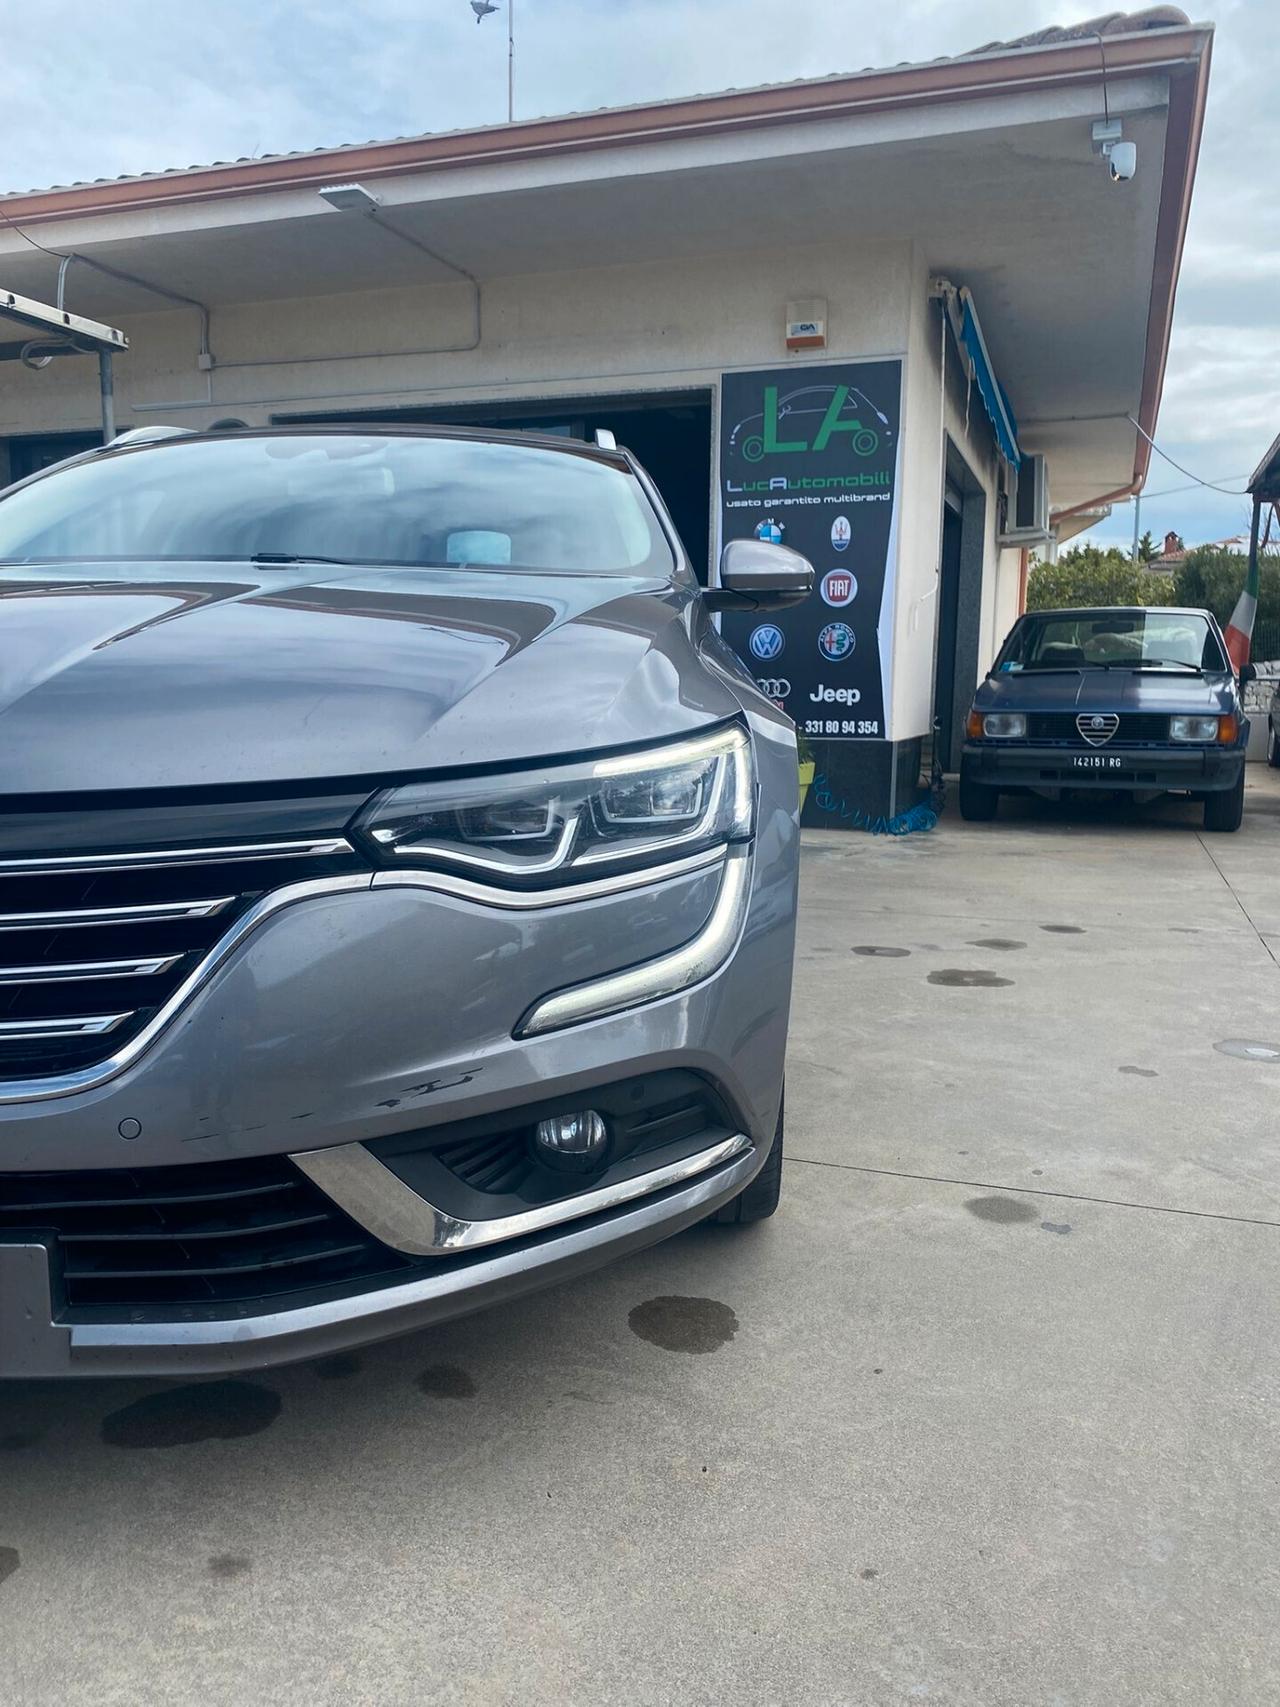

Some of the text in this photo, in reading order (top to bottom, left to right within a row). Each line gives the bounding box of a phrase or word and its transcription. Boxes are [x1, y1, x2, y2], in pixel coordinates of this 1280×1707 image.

[727, 471, 890, 492] LucAutomobili
[726, 492, 890, 508] usato garantito multibrand
[830, 579, 849, 597] FIAT
[809, 684, 861, 706] Jeep
[805, 720, 823, 733] 331
[825, 720, 839, 733] 80
[842, 721, 856, 734] 94
[857, 721, 879, 734] 354
[1073, 757, 1121, 767] 142151 RG
